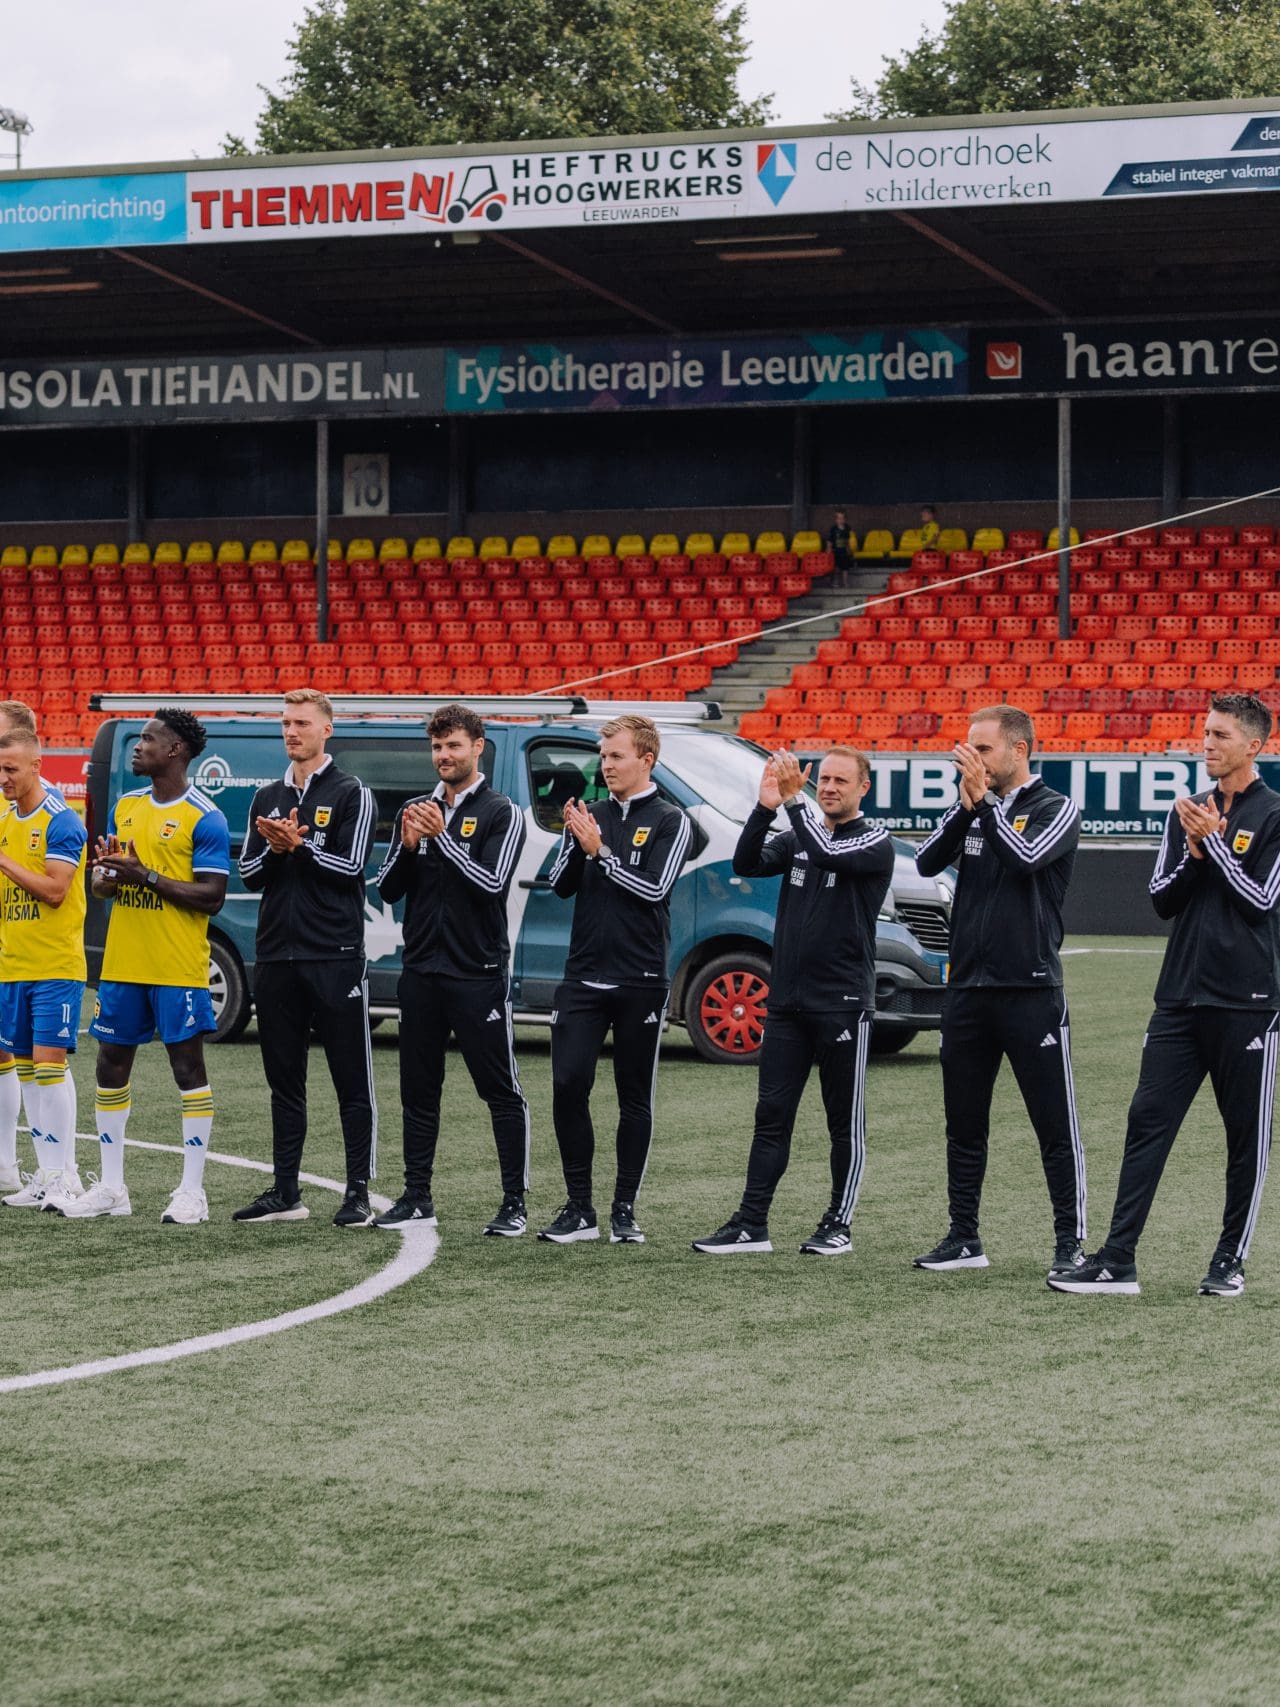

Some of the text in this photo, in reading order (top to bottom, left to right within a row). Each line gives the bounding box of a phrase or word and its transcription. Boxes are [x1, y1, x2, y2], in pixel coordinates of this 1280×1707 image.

[513, 142, 743, 180] HEFTRUCKS
[815, 132, 1054, 172] de Noordhoek
[512, 172, 743, 206] HOOGWERKERS
[865, 173, 1053, 204] schilderwerken
[1132, 168, 1176, 185] stabiel
[1180, 167, 1228, 184] integer
[191, 171, 444, 231] THEMMEN
[582, 205, 680, 222] LEEUWARDEN
[458, 341, 955, 404] Fysiotherapie Leeuwarden
[916, 815, 932, 829] in
[1146, 817, 1163, 832] in
[185, 990, 193, 1012] 5
